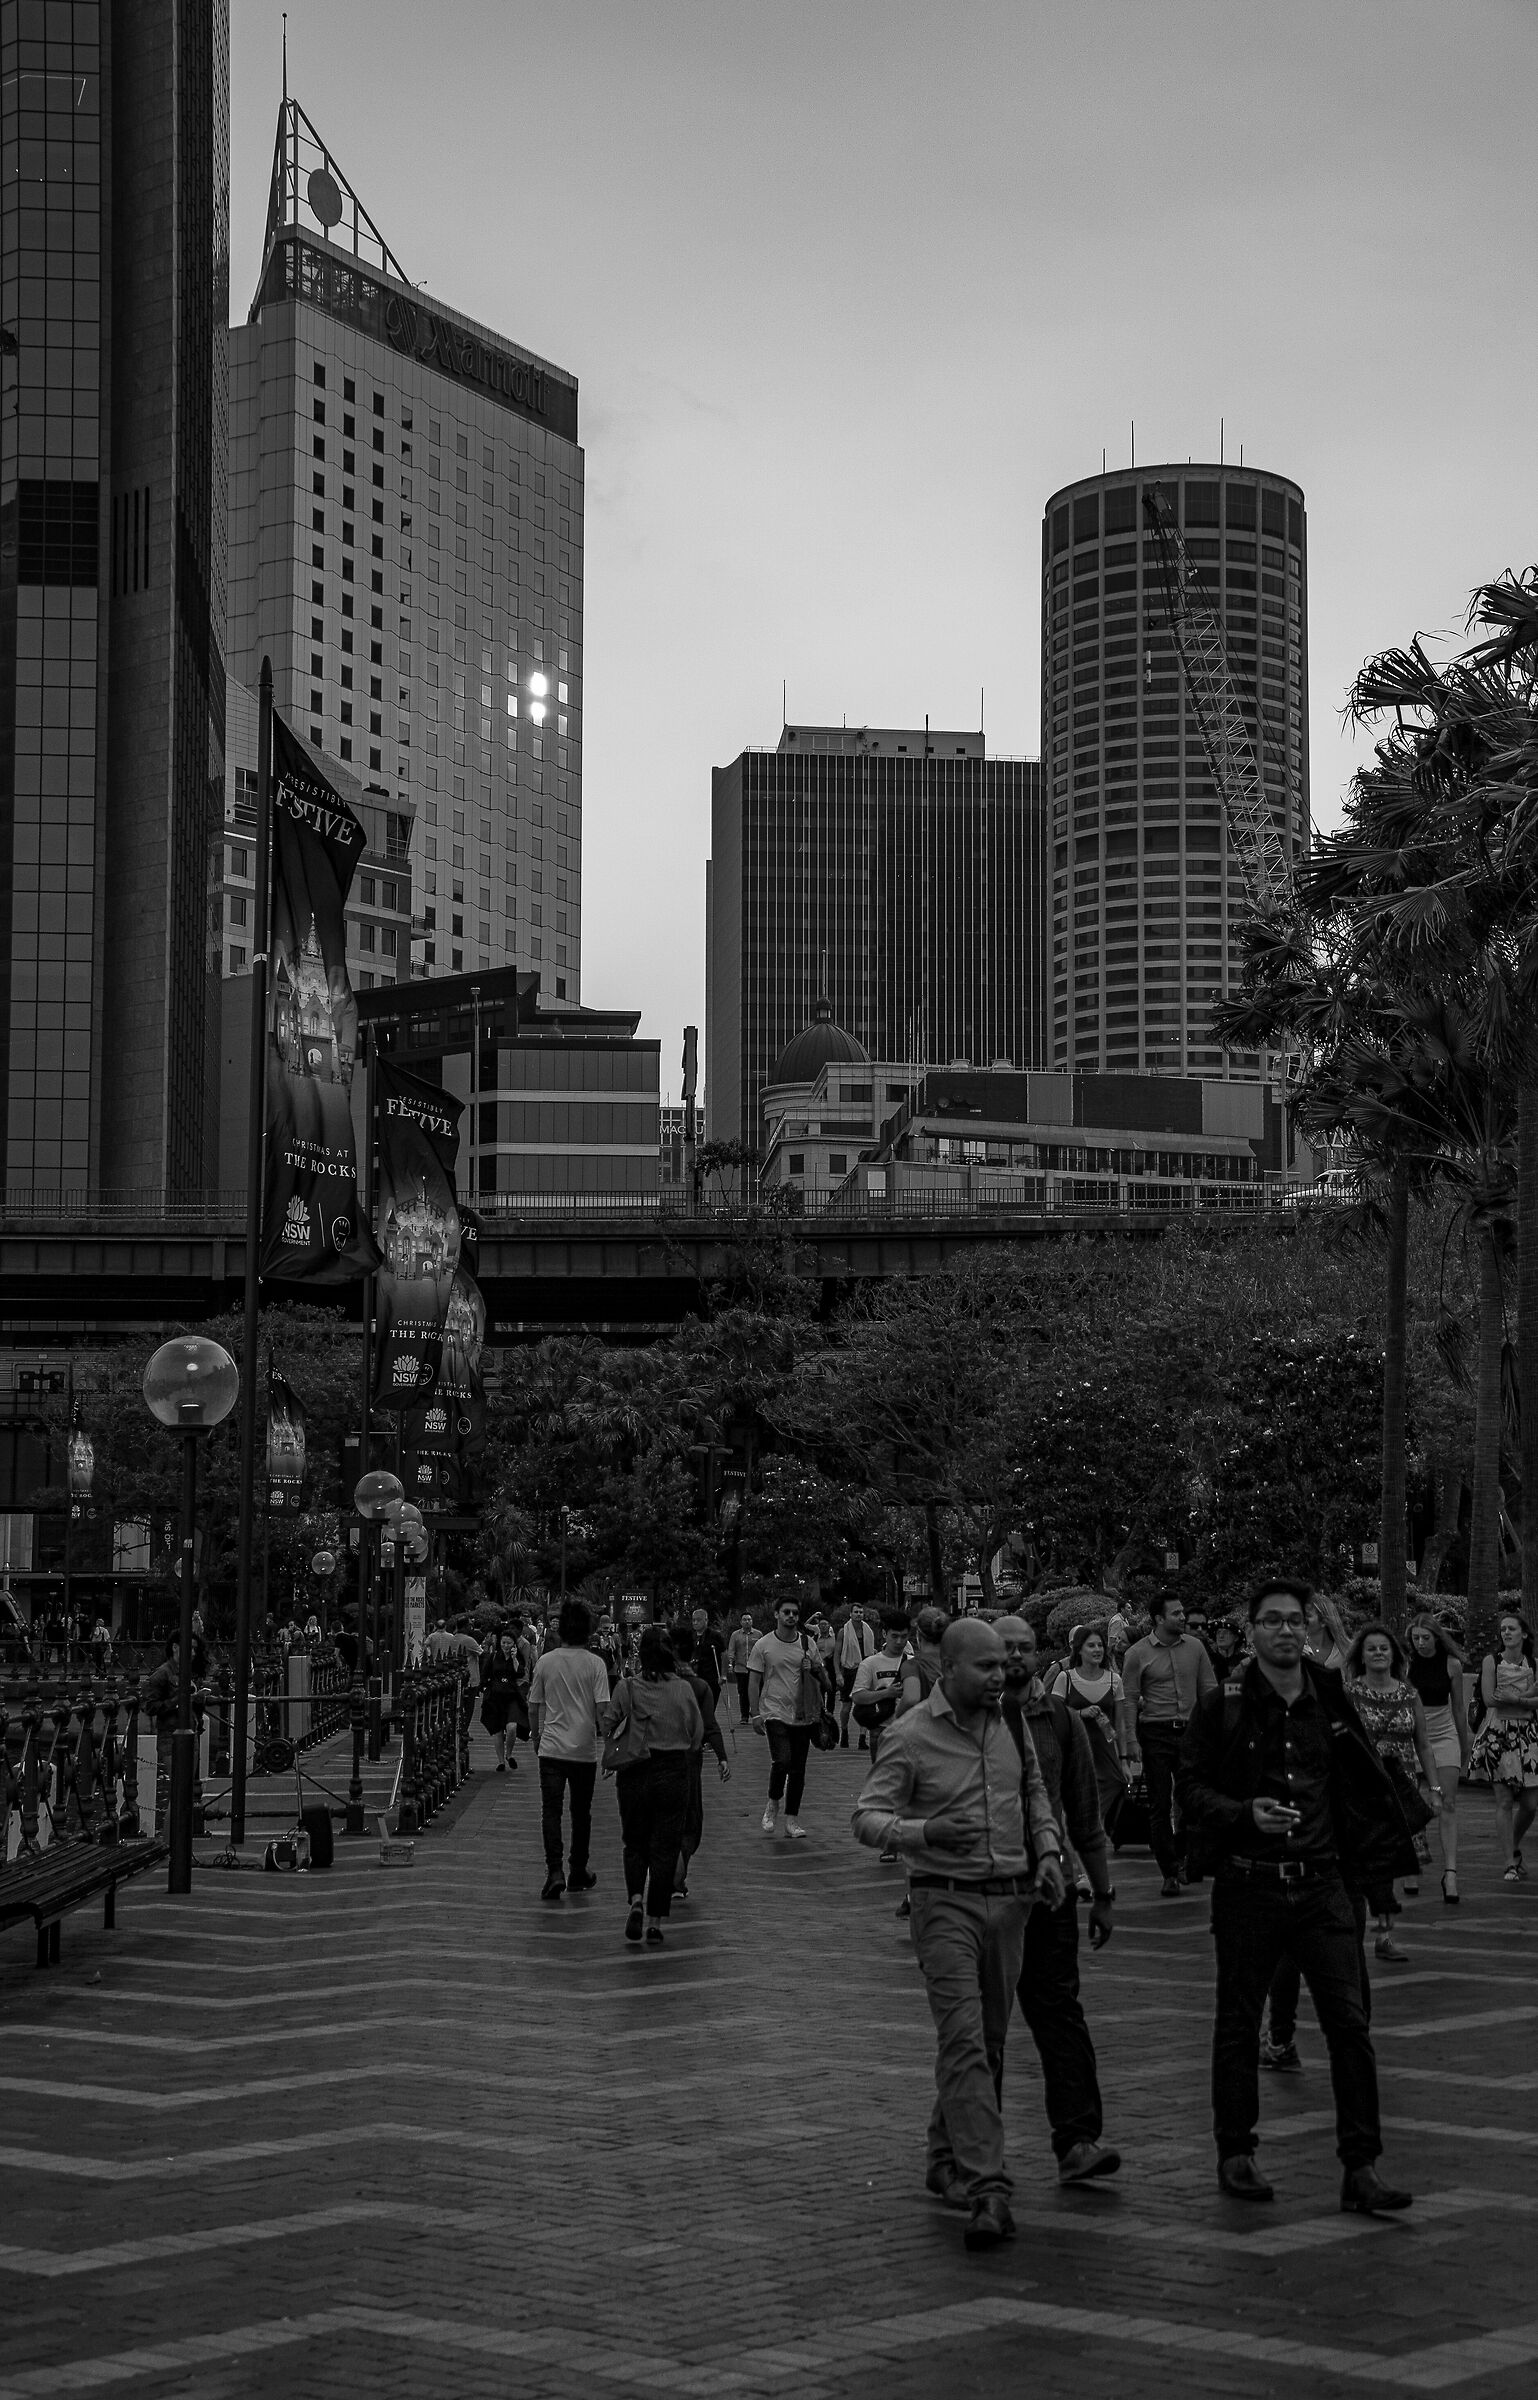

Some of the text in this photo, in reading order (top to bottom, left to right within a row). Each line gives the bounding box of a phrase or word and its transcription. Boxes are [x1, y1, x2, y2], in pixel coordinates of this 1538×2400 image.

[420, 315, 549, 416] Marriott
[386, 1098, 452, 1137] FETIVE
[659, 1125, 704, 1135] MACU
[336, 1149, 349, 1158] AT
[284, 1151, 358, 1179] THE ROCKS
[281, 1221, 311, 1241] NSW
[390, 1329, 416, 1339] THE
[392, 1372, 419, 1384] NSW
[424, 1421, 447, 1431] NSW
[417, 1474, 433, 1482] NSW
